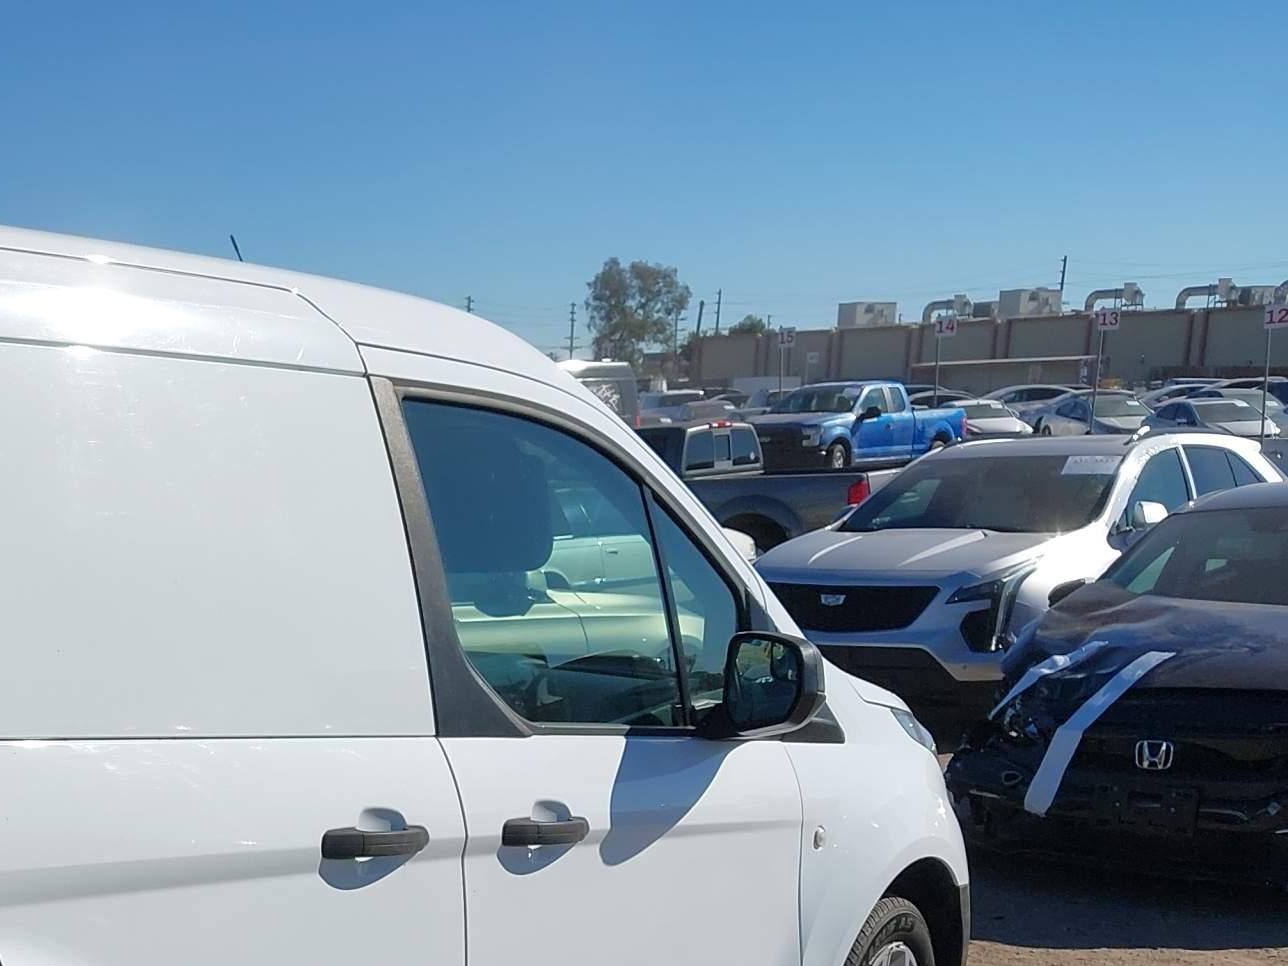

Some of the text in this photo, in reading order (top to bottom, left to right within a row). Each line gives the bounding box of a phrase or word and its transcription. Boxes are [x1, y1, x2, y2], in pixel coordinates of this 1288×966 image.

[1099, 311, 1119, 326] 13
[936, 319, 955, 333] 14
[780, 332, 794, 344] 15
